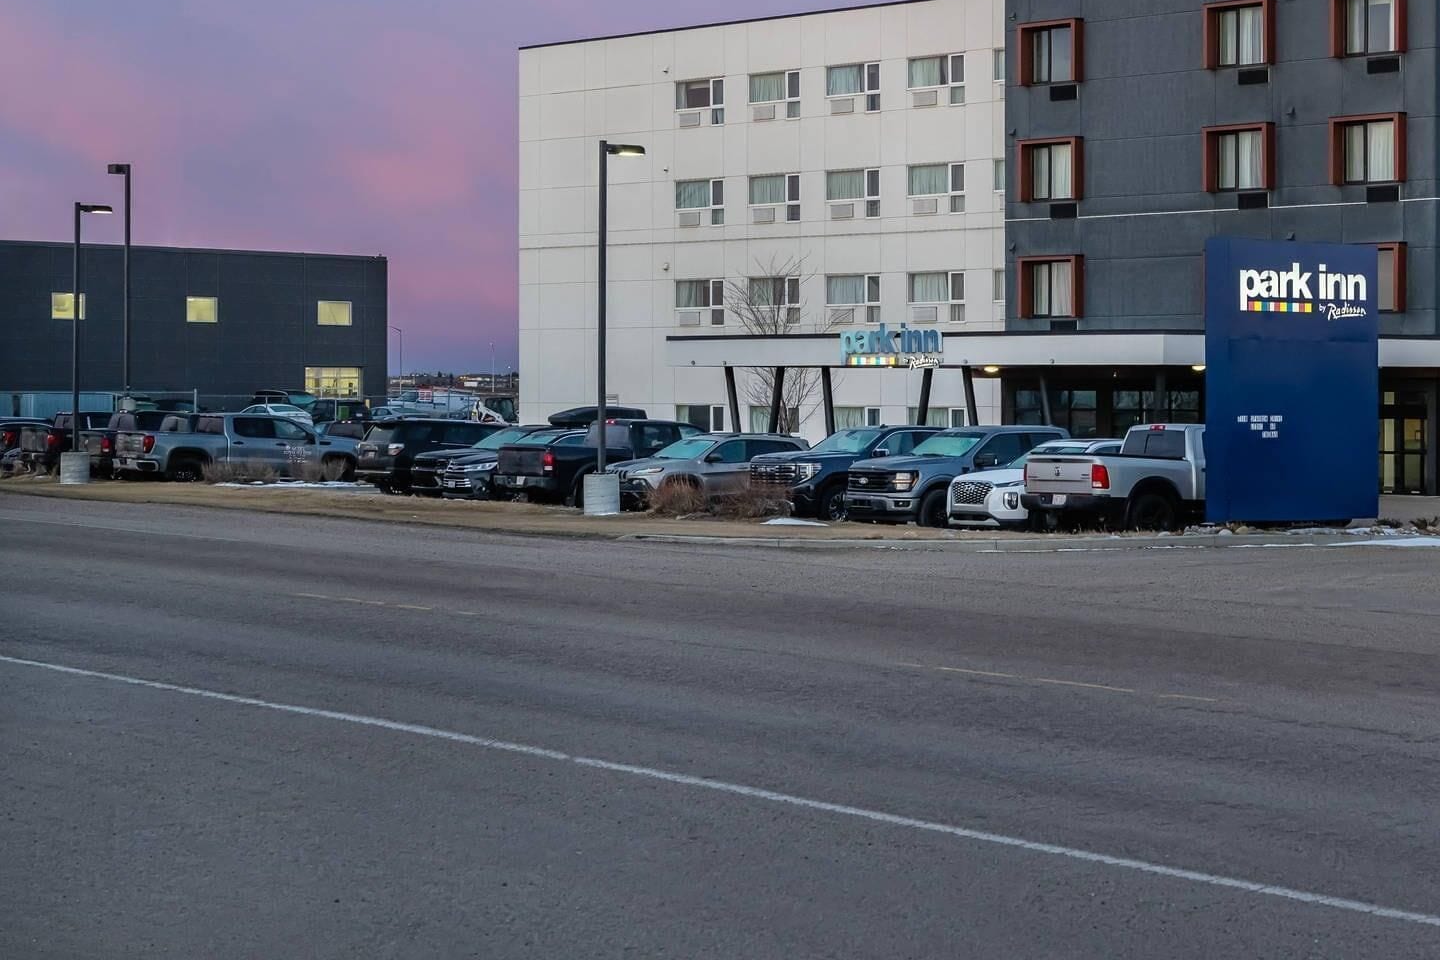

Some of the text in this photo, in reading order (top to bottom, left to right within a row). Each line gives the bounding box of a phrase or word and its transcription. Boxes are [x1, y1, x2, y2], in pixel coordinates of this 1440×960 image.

[1240, 262, 1367, 311] park inn
[1319, 302, 1367, 320] by Radisson
[840, 322, 943, 366] park inn
